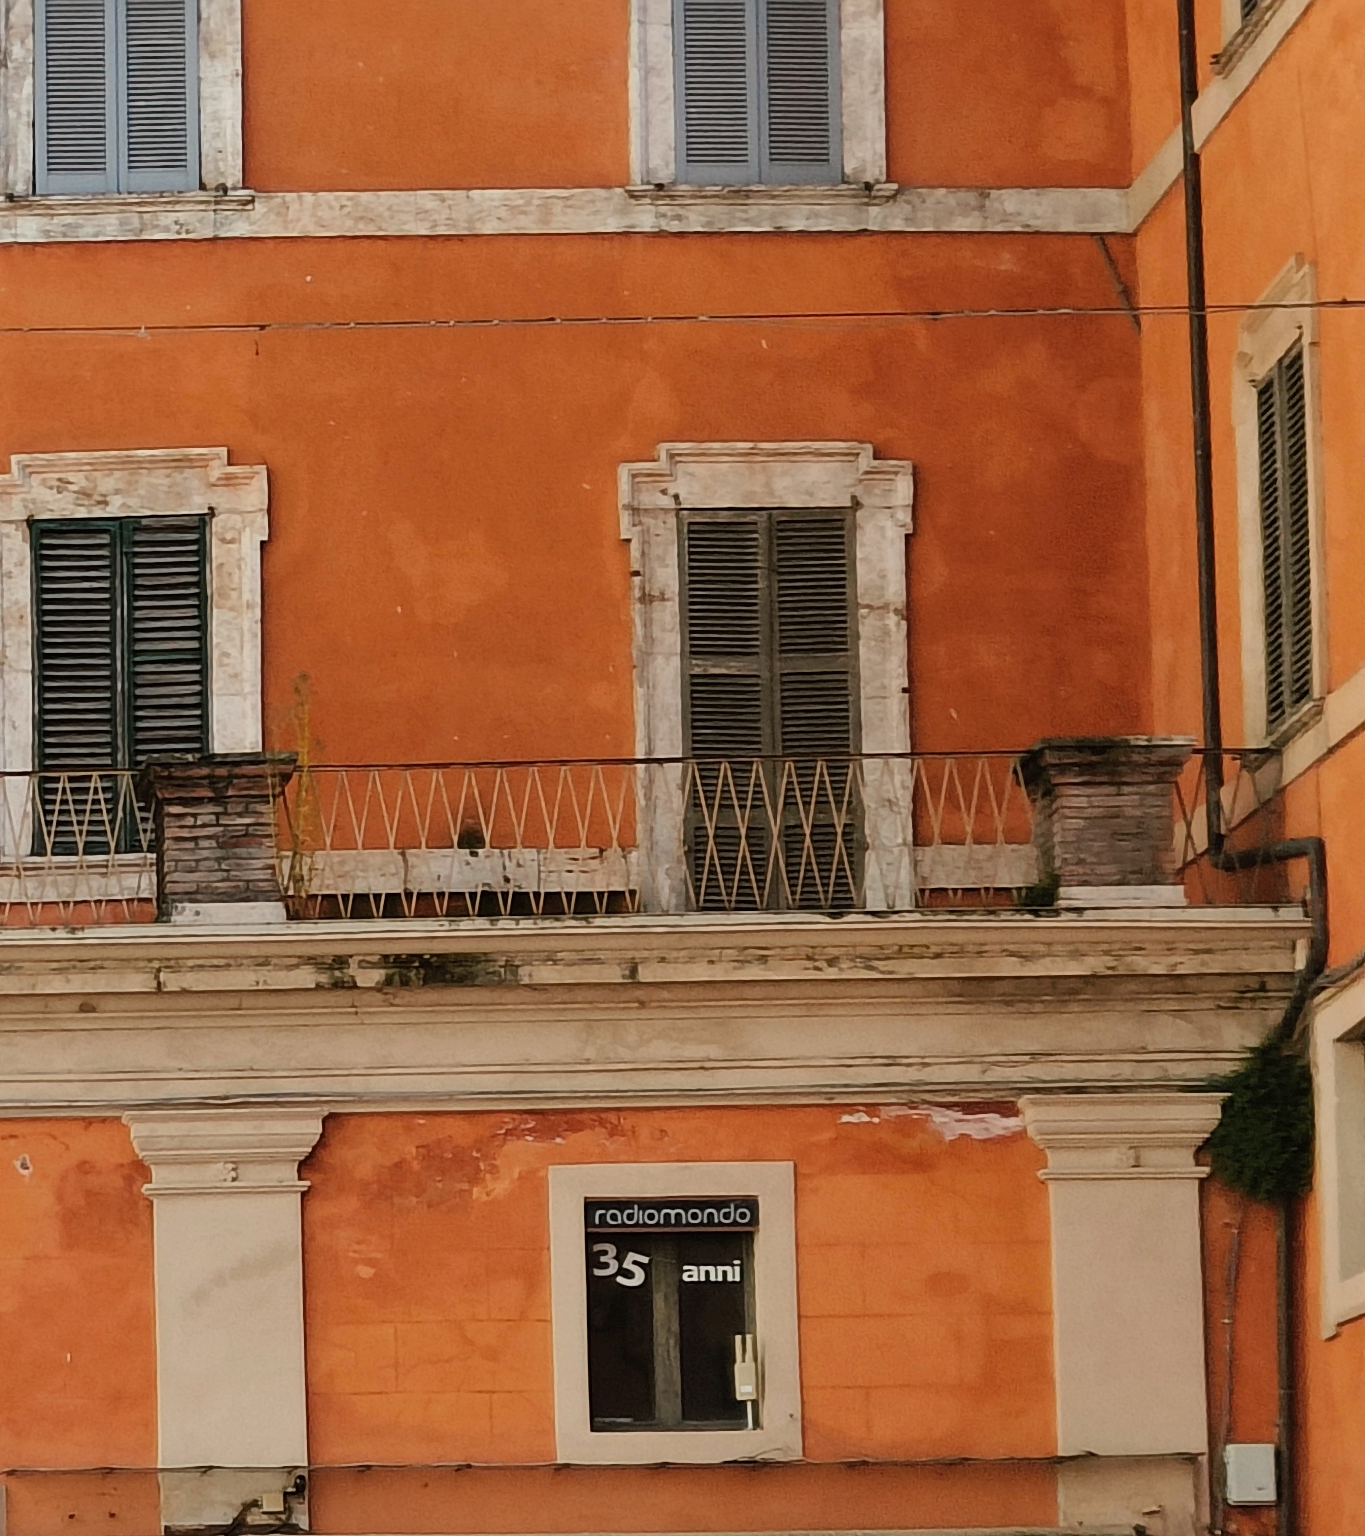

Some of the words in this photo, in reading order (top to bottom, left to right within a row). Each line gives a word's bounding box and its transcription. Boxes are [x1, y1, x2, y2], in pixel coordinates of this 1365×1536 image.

[595, 1203, 751, 1225] radiomondo
[592, 1242, 650, 1287] 35
[682, 1260, 741, 1282] anni
